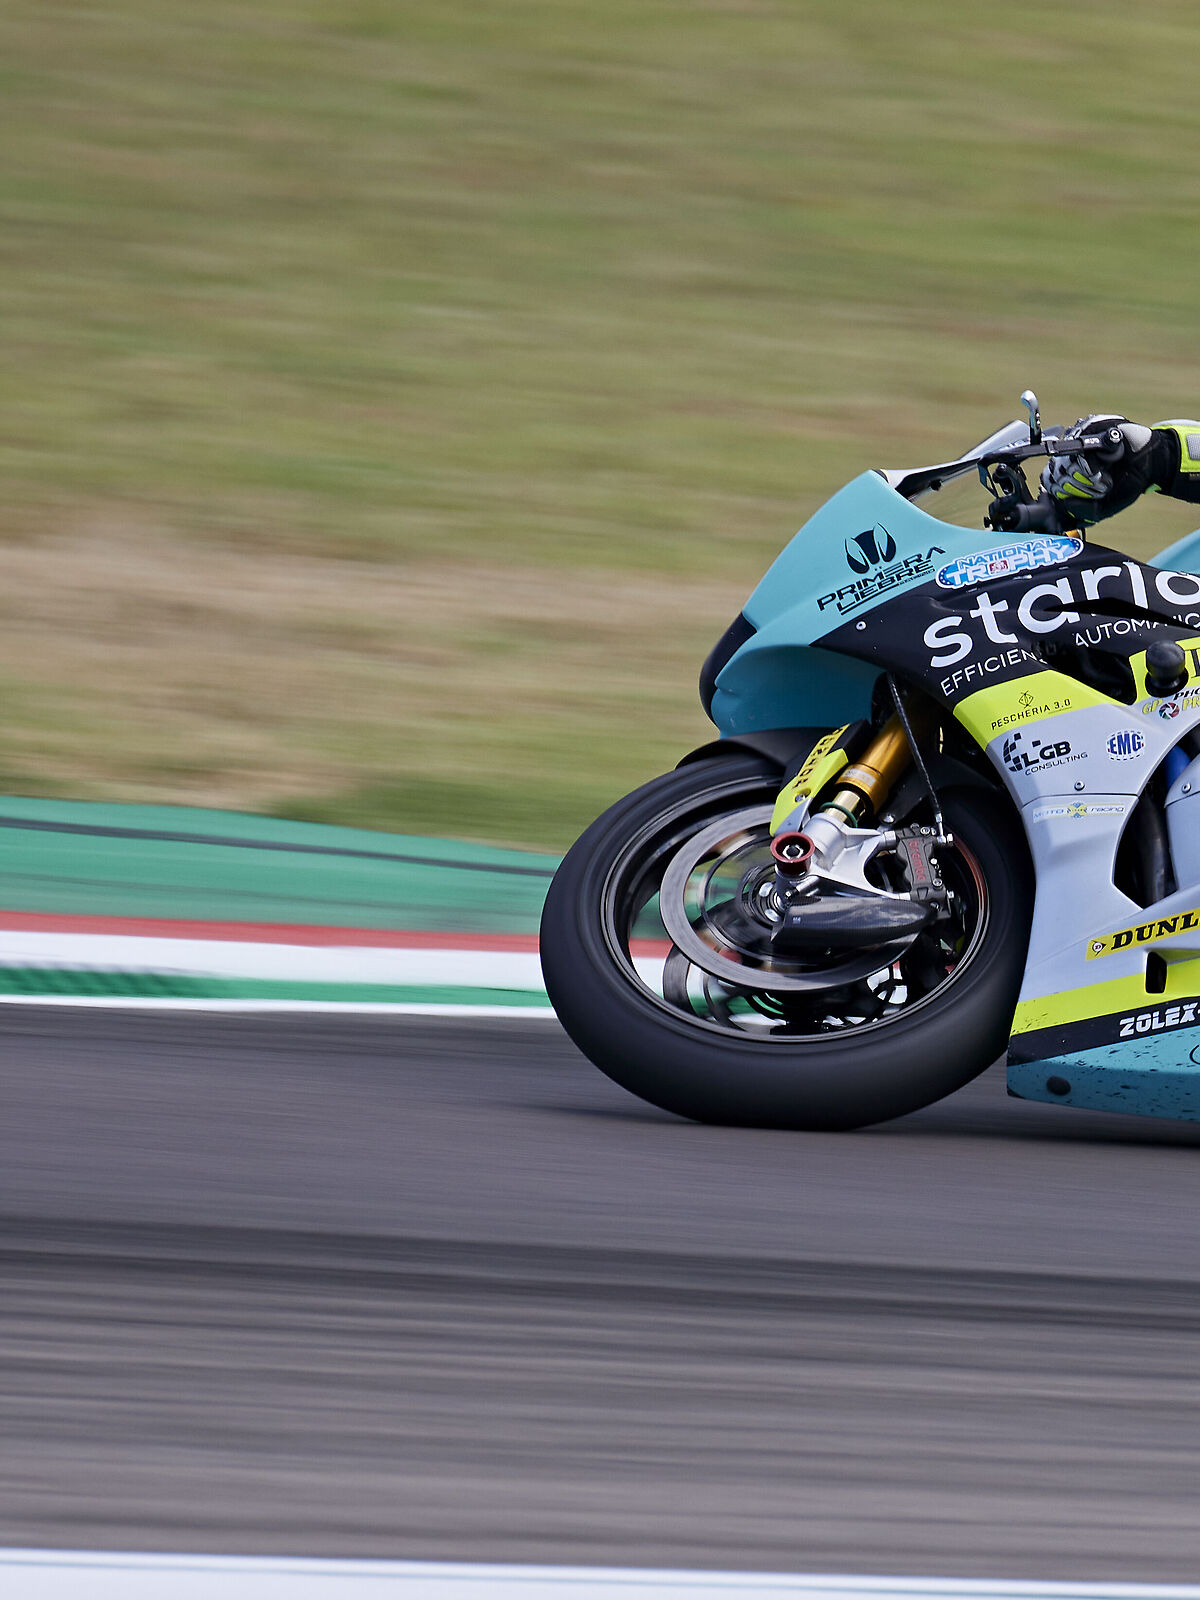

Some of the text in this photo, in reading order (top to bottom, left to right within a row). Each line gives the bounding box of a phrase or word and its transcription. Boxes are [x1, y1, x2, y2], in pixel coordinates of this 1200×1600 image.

[957, 538, 1062, 569] NATIONAL
[991, 704, 1051, 731] PESCHERIA
[1054, 698, 1071, 710] 3.0
[1021, 741, 1071, 767] LGB
[1109, 732, 1141, 756] EMG
[1025, 751, 1088, 776] CONSULTING
[908, 840, 926, 881] brembo
